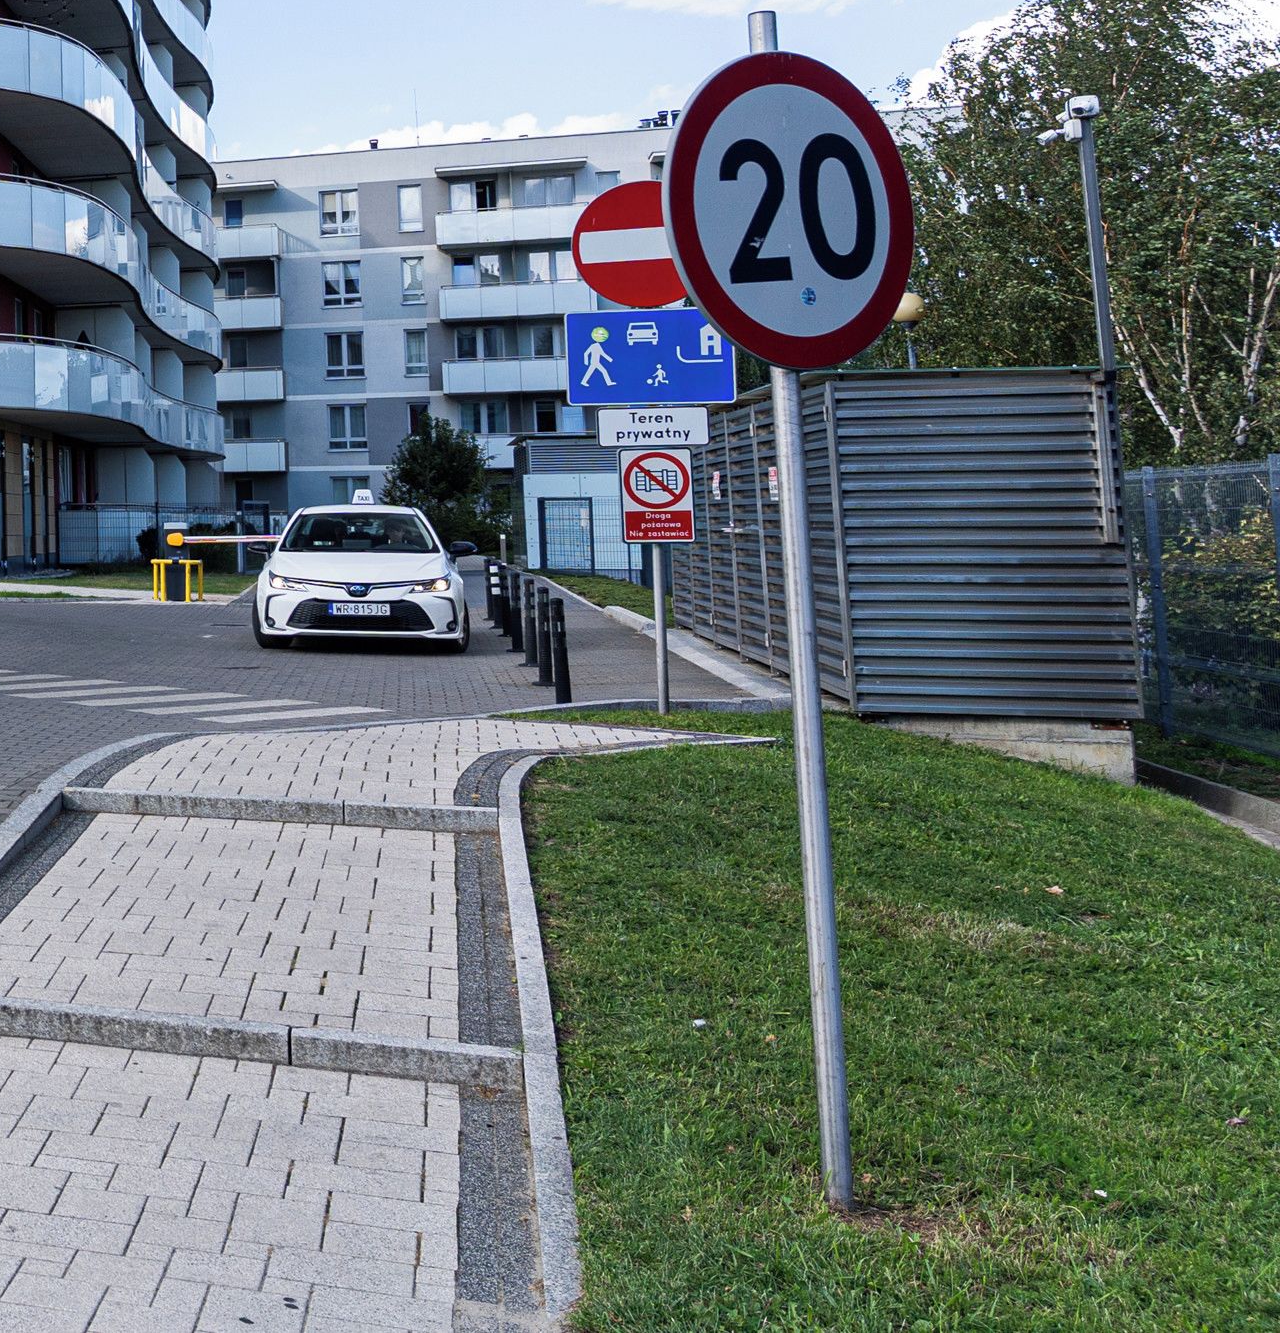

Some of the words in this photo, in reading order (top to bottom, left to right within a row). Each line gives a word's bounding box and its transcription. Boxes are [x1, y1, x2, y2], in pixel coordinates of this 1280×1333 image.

[719, 132, 877, 285] 20
[629, 412, 674, 424] Teren
[616, 427, 691, 443] prywatny
[645, 512, 671, 521] Droga
[641, 521, 681, 529] pożarowa
[648, 529, 690, 537] zastawiać
[335, 604, 349, 614] WR
[353, 604, 388, 614] 815JG
